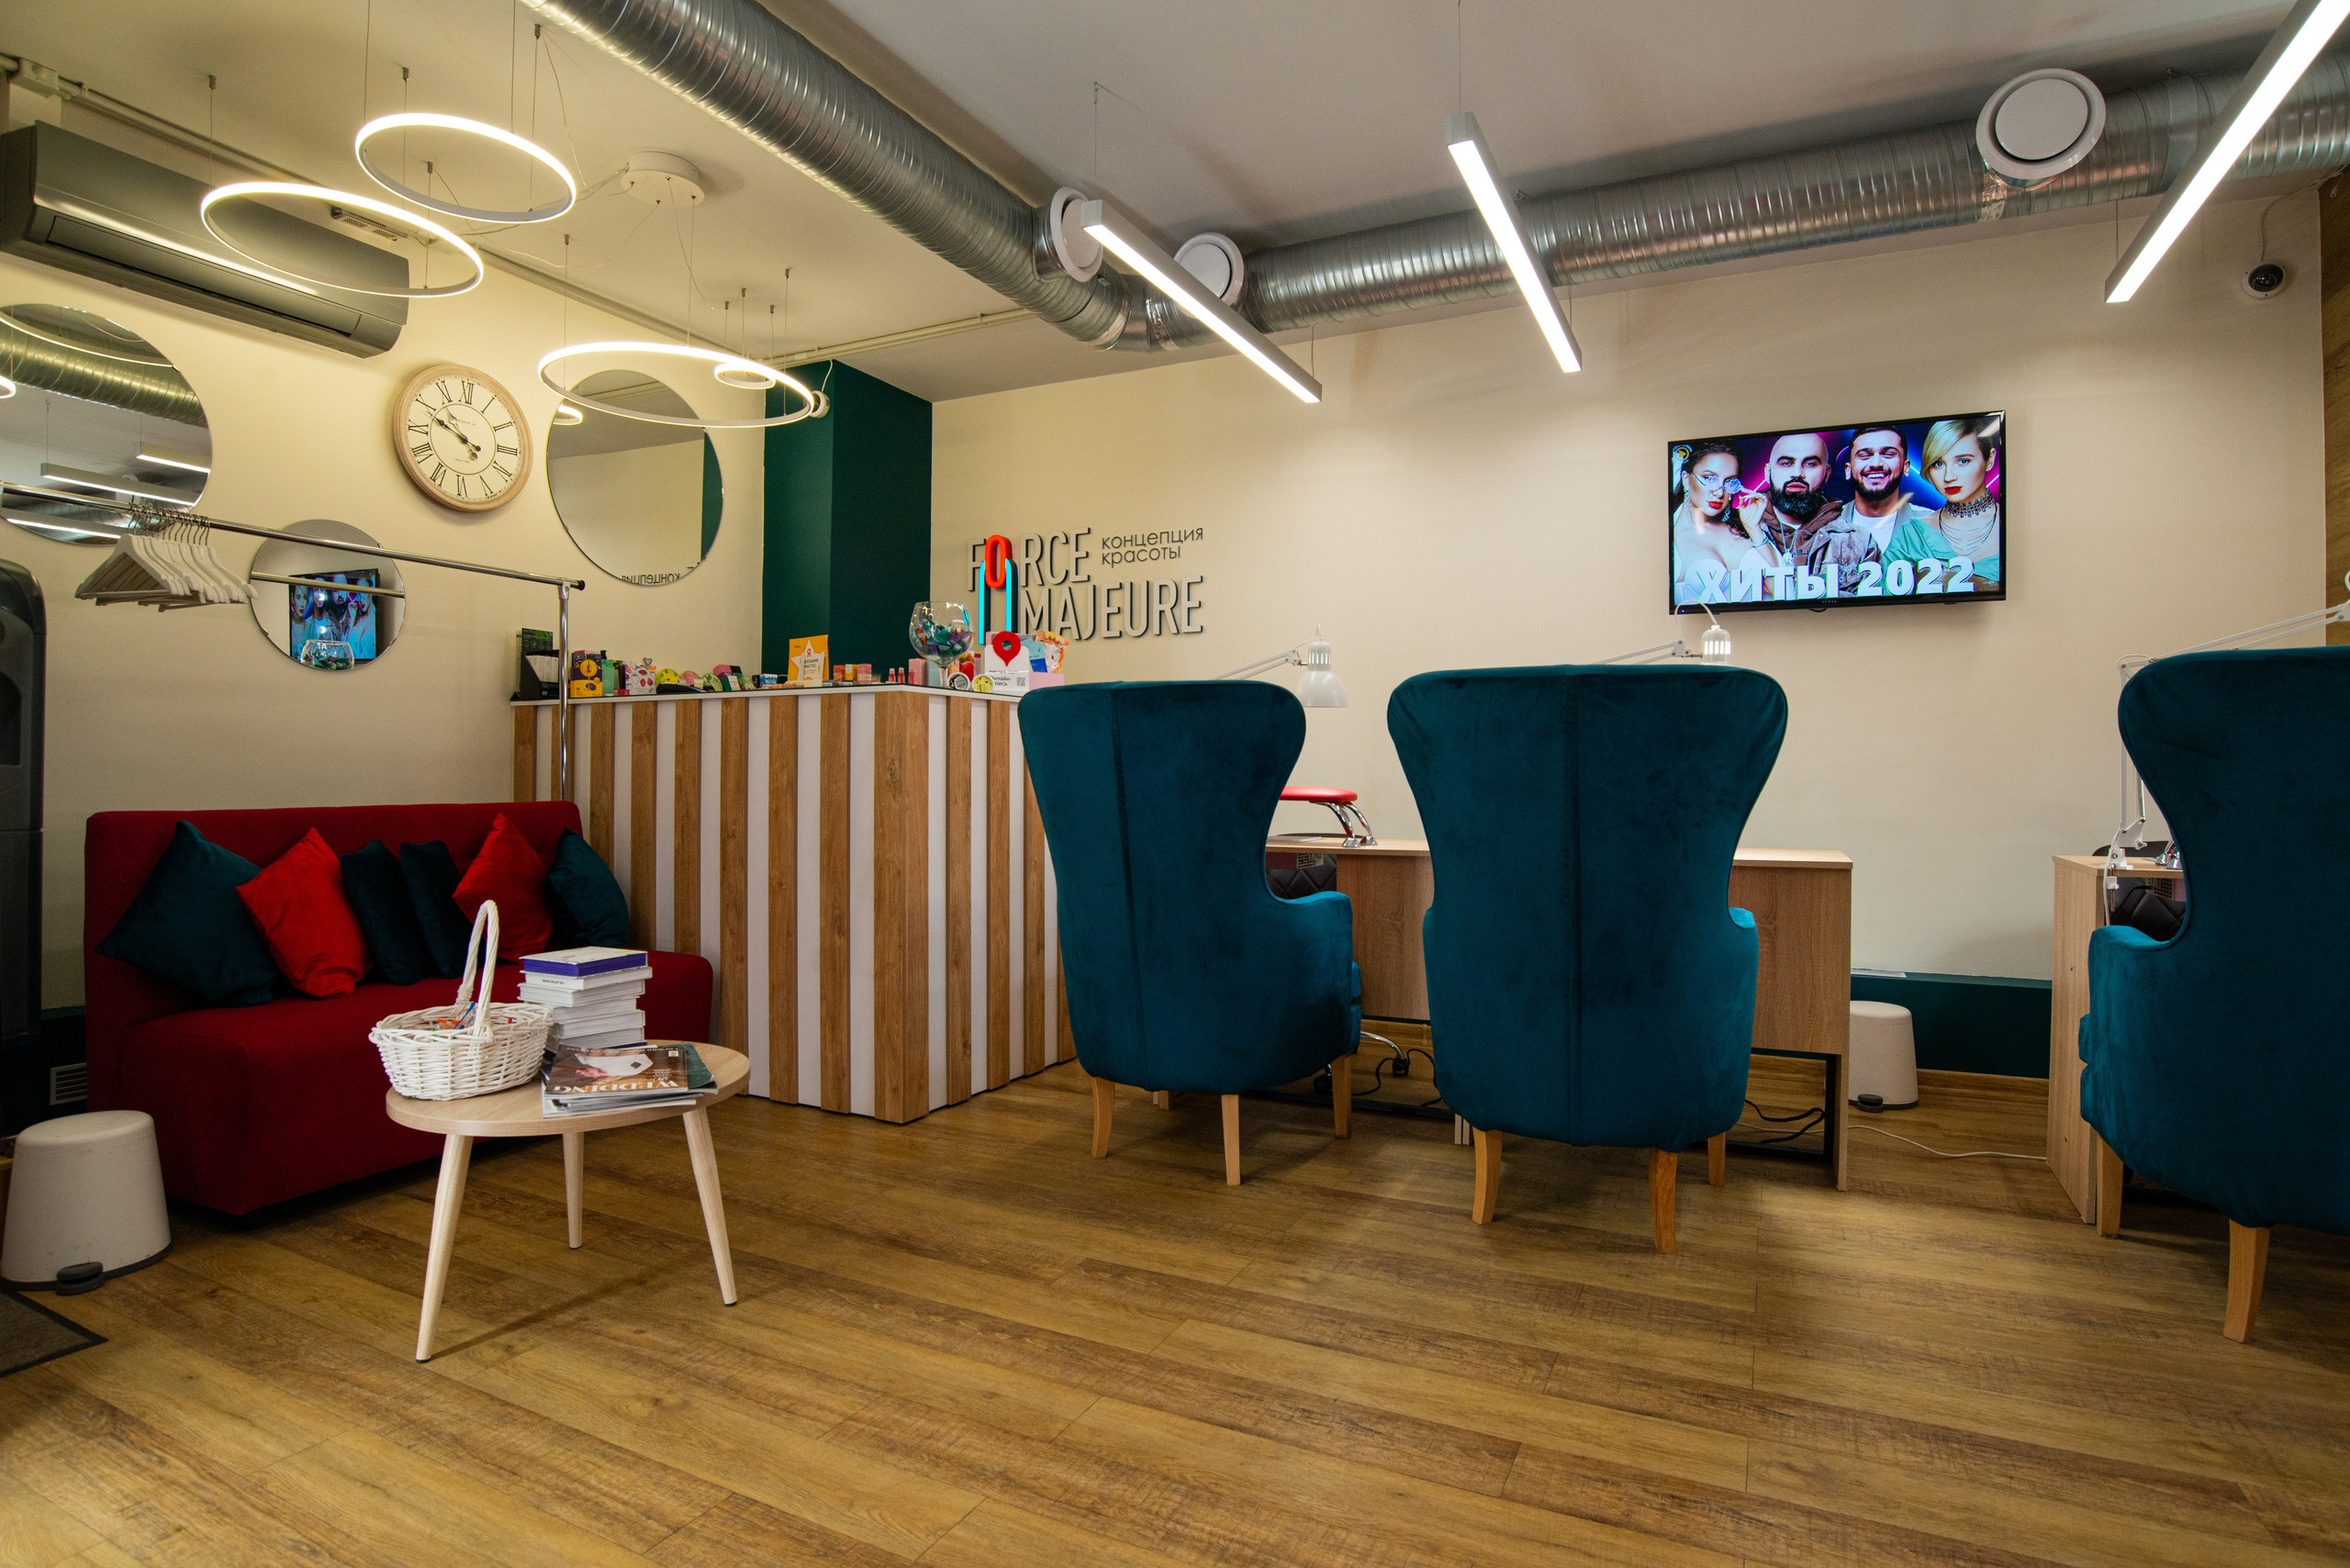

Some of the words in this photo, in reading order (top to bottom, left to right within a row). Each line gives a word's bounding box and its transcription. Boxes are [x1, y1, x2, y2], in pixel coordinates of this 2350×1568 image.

[459, 381, 475, 405] XII
[1102, 528, 1203, 550] концепция
[967, 527, 1091, 592] FORCE
[1102, 546, 1181, 567] красоты
[1696, 563, 1840, 604] ХИТЫ
[1856, 556, 1975, 597] 2022
[1020, 576, 1203, 641] MAJEURE
[553, 1081, 678, 1093] WEDDING
